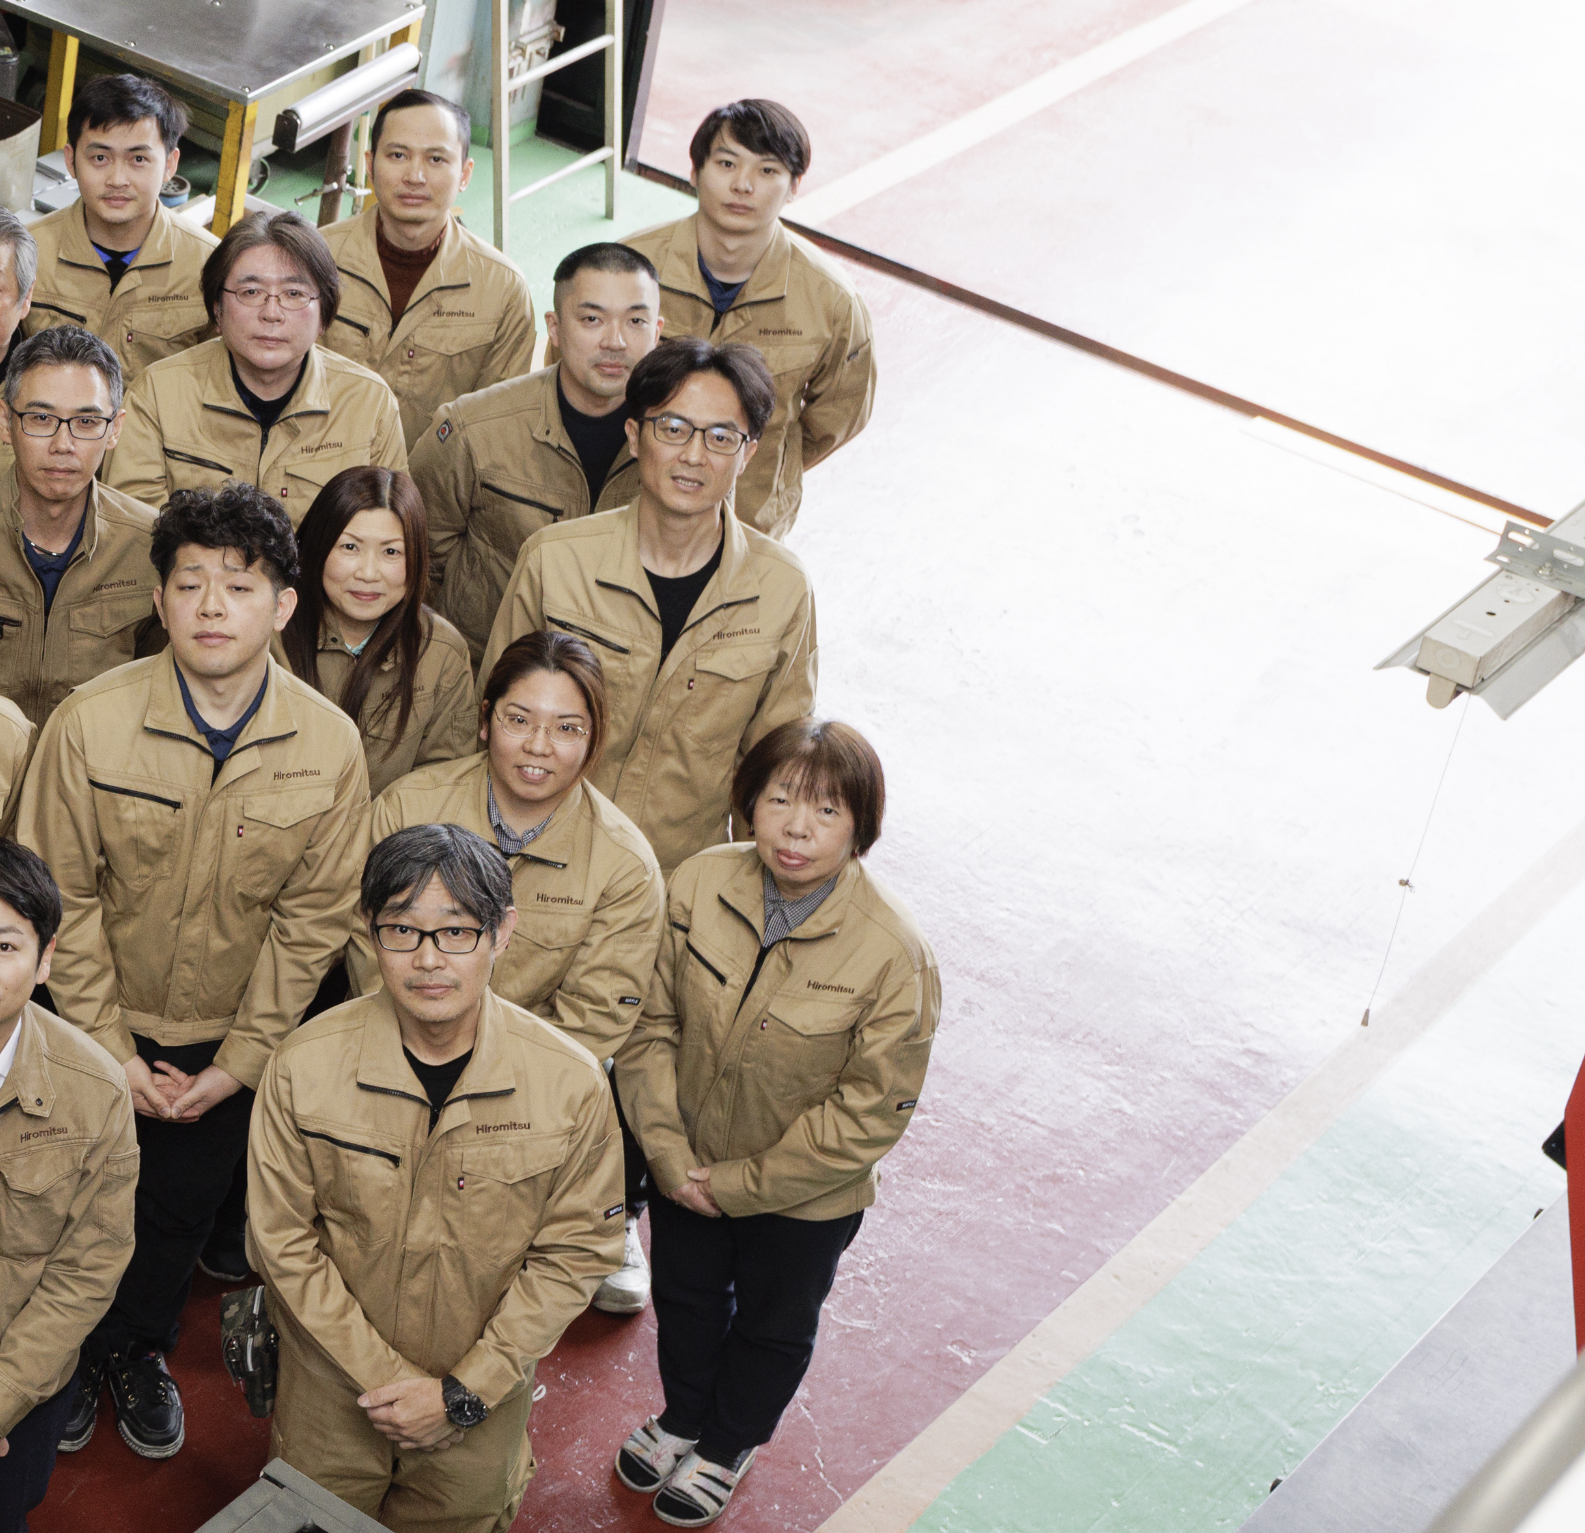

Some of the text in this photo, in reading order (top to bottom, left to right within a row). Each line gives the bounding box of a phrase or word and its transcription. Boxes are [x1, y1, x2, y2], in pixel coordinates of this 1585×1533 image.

[148, 294, 189, 303] Hiromitsu
[432, 309, 475, 318] Hiromitsu
[758, 328, 803, 336] Hiromitsu
[300, 441, 343, 454] Hiromitsu
[92, 579, 138, 593] Hiromitsu
[713, 628, 761, 640] Hiromitsu
[273, 769, 321, 781] Hiromitsu
[536, 892, 584, 906] Hiromitsu
[807, 979, 855, 994] Hiromitsu
[20, 1126, 69, 1143] Hiromitsu
[476, 1121, 531, 1135] Hiromitsu
